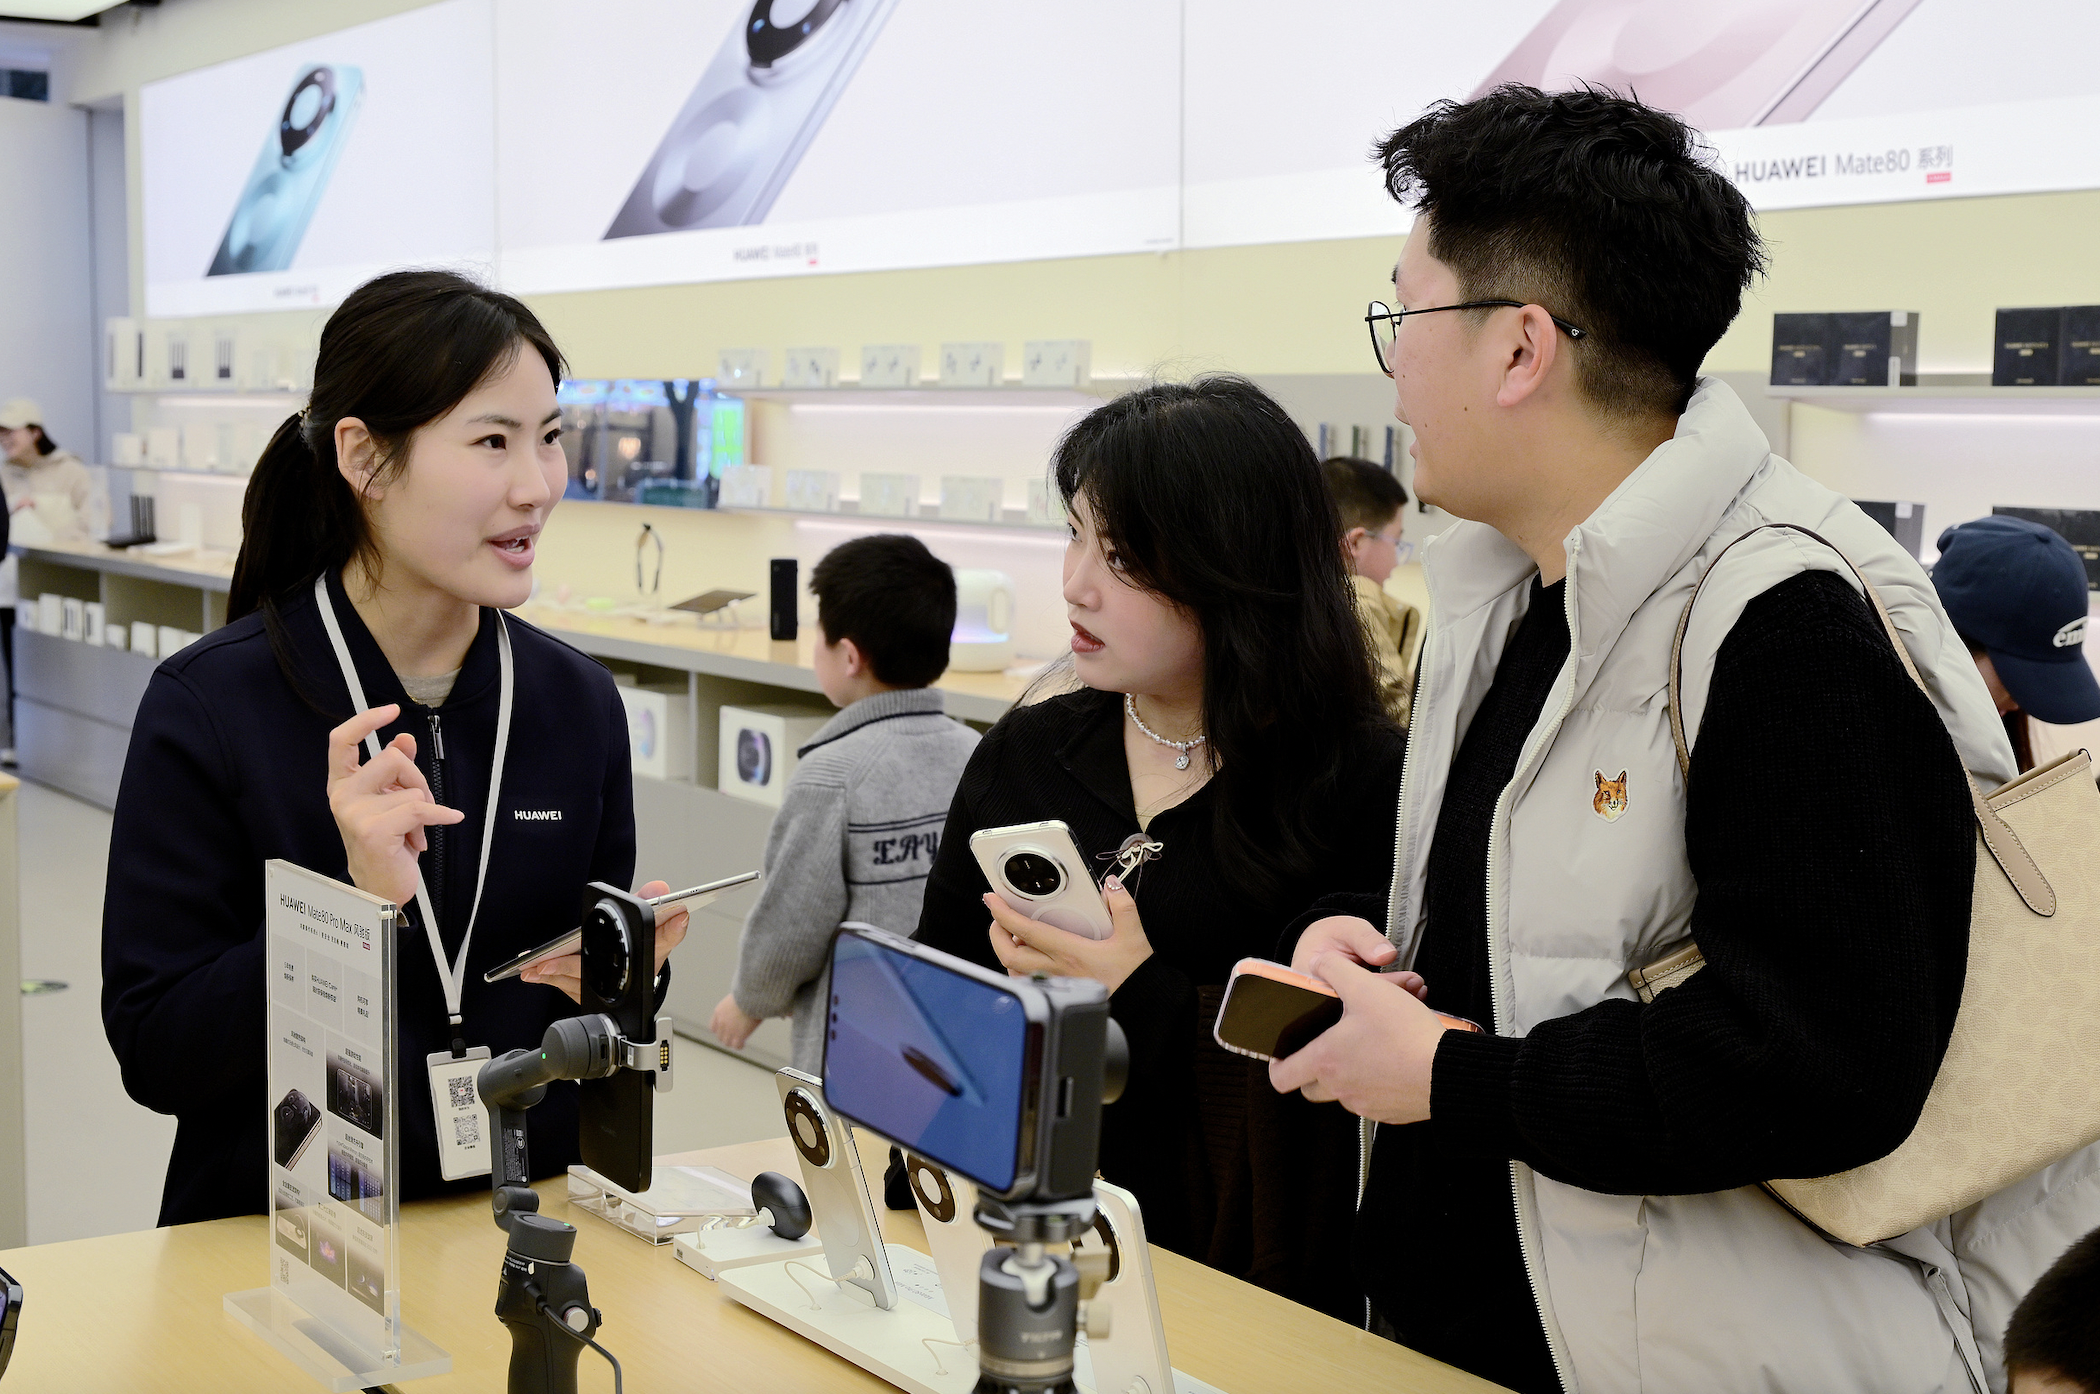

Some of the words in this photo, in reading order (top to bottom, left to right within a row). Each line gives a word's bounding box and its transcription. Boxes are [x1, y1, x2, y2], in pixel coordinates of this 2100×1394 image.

[1735, 155, 1827, 183] HUAWEI
[1835, 149, 1911, 175] Mate80
[1917, 145, 1954, 170] 系列
[514, 810, 562, 821] HUAWEI
[280, 893, 306, 915] HUAWEI
[307, 904, 328, 924] Mate80
[329, 913, 338, 929] Pro
[340, 917, 353, 935] Max
